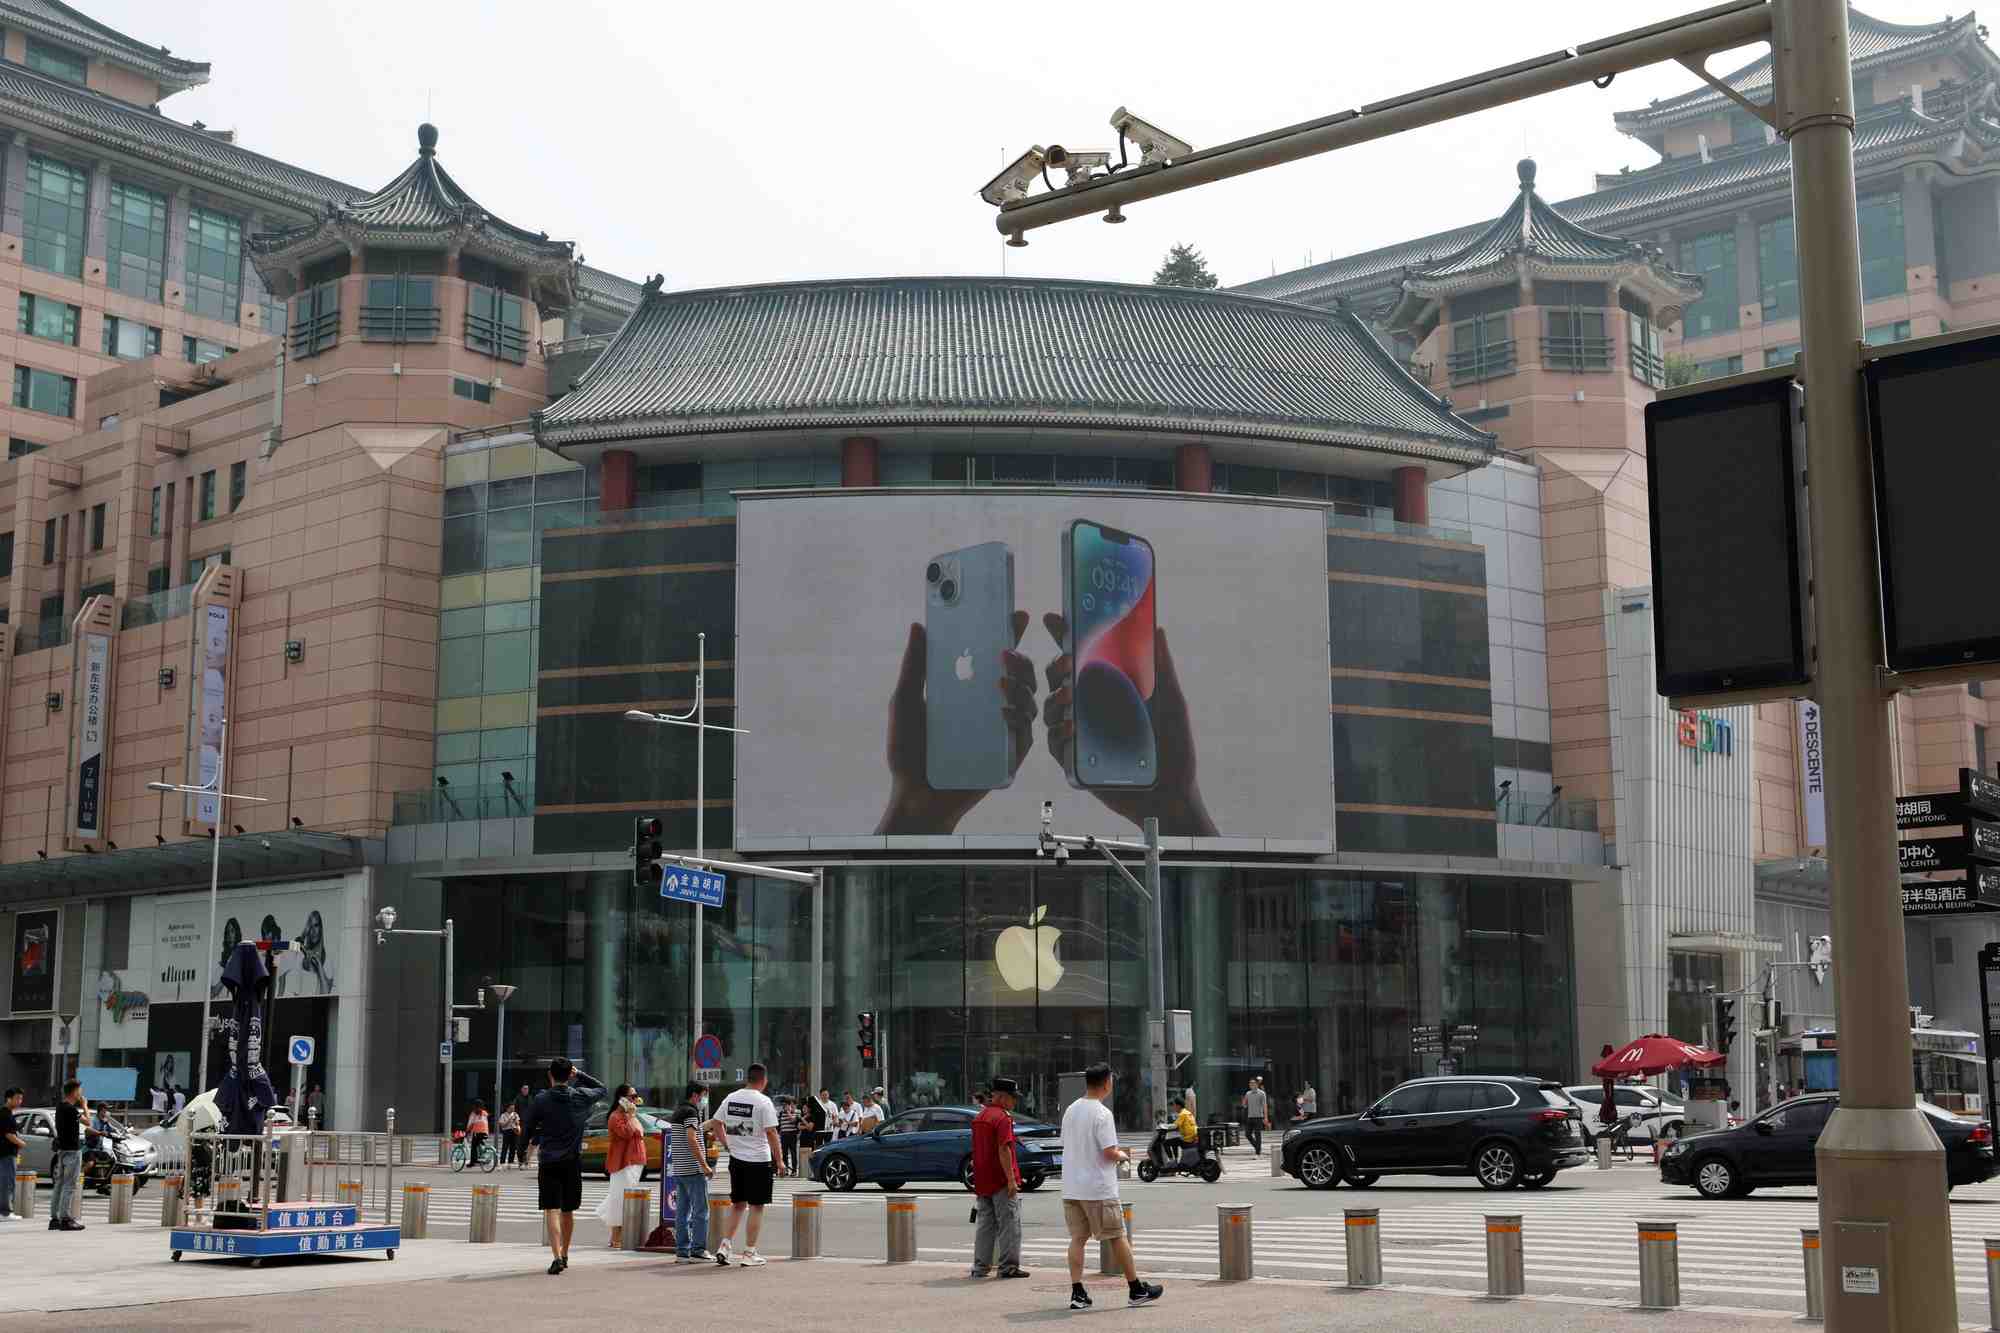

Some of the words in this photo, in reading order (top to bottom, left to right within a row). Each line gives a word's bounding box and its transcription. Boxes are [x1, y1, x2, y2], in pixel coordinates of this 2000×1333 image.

[1805, 721, 1822, 794] DESCENTE
[1912, 814, 1946, 823] HUTONG
[1910, 859, 1940, 867] CENTER
[680, 873, 721, 892] 金鱼胡同
[1903, 902, 1944, 912] ENINSULA
[1945, 900, 1976, 911] BEIJING
[278, 1210, 345, 1227] 值勤岗台
[299, 1233, 365, 1251] 值勤岗台
